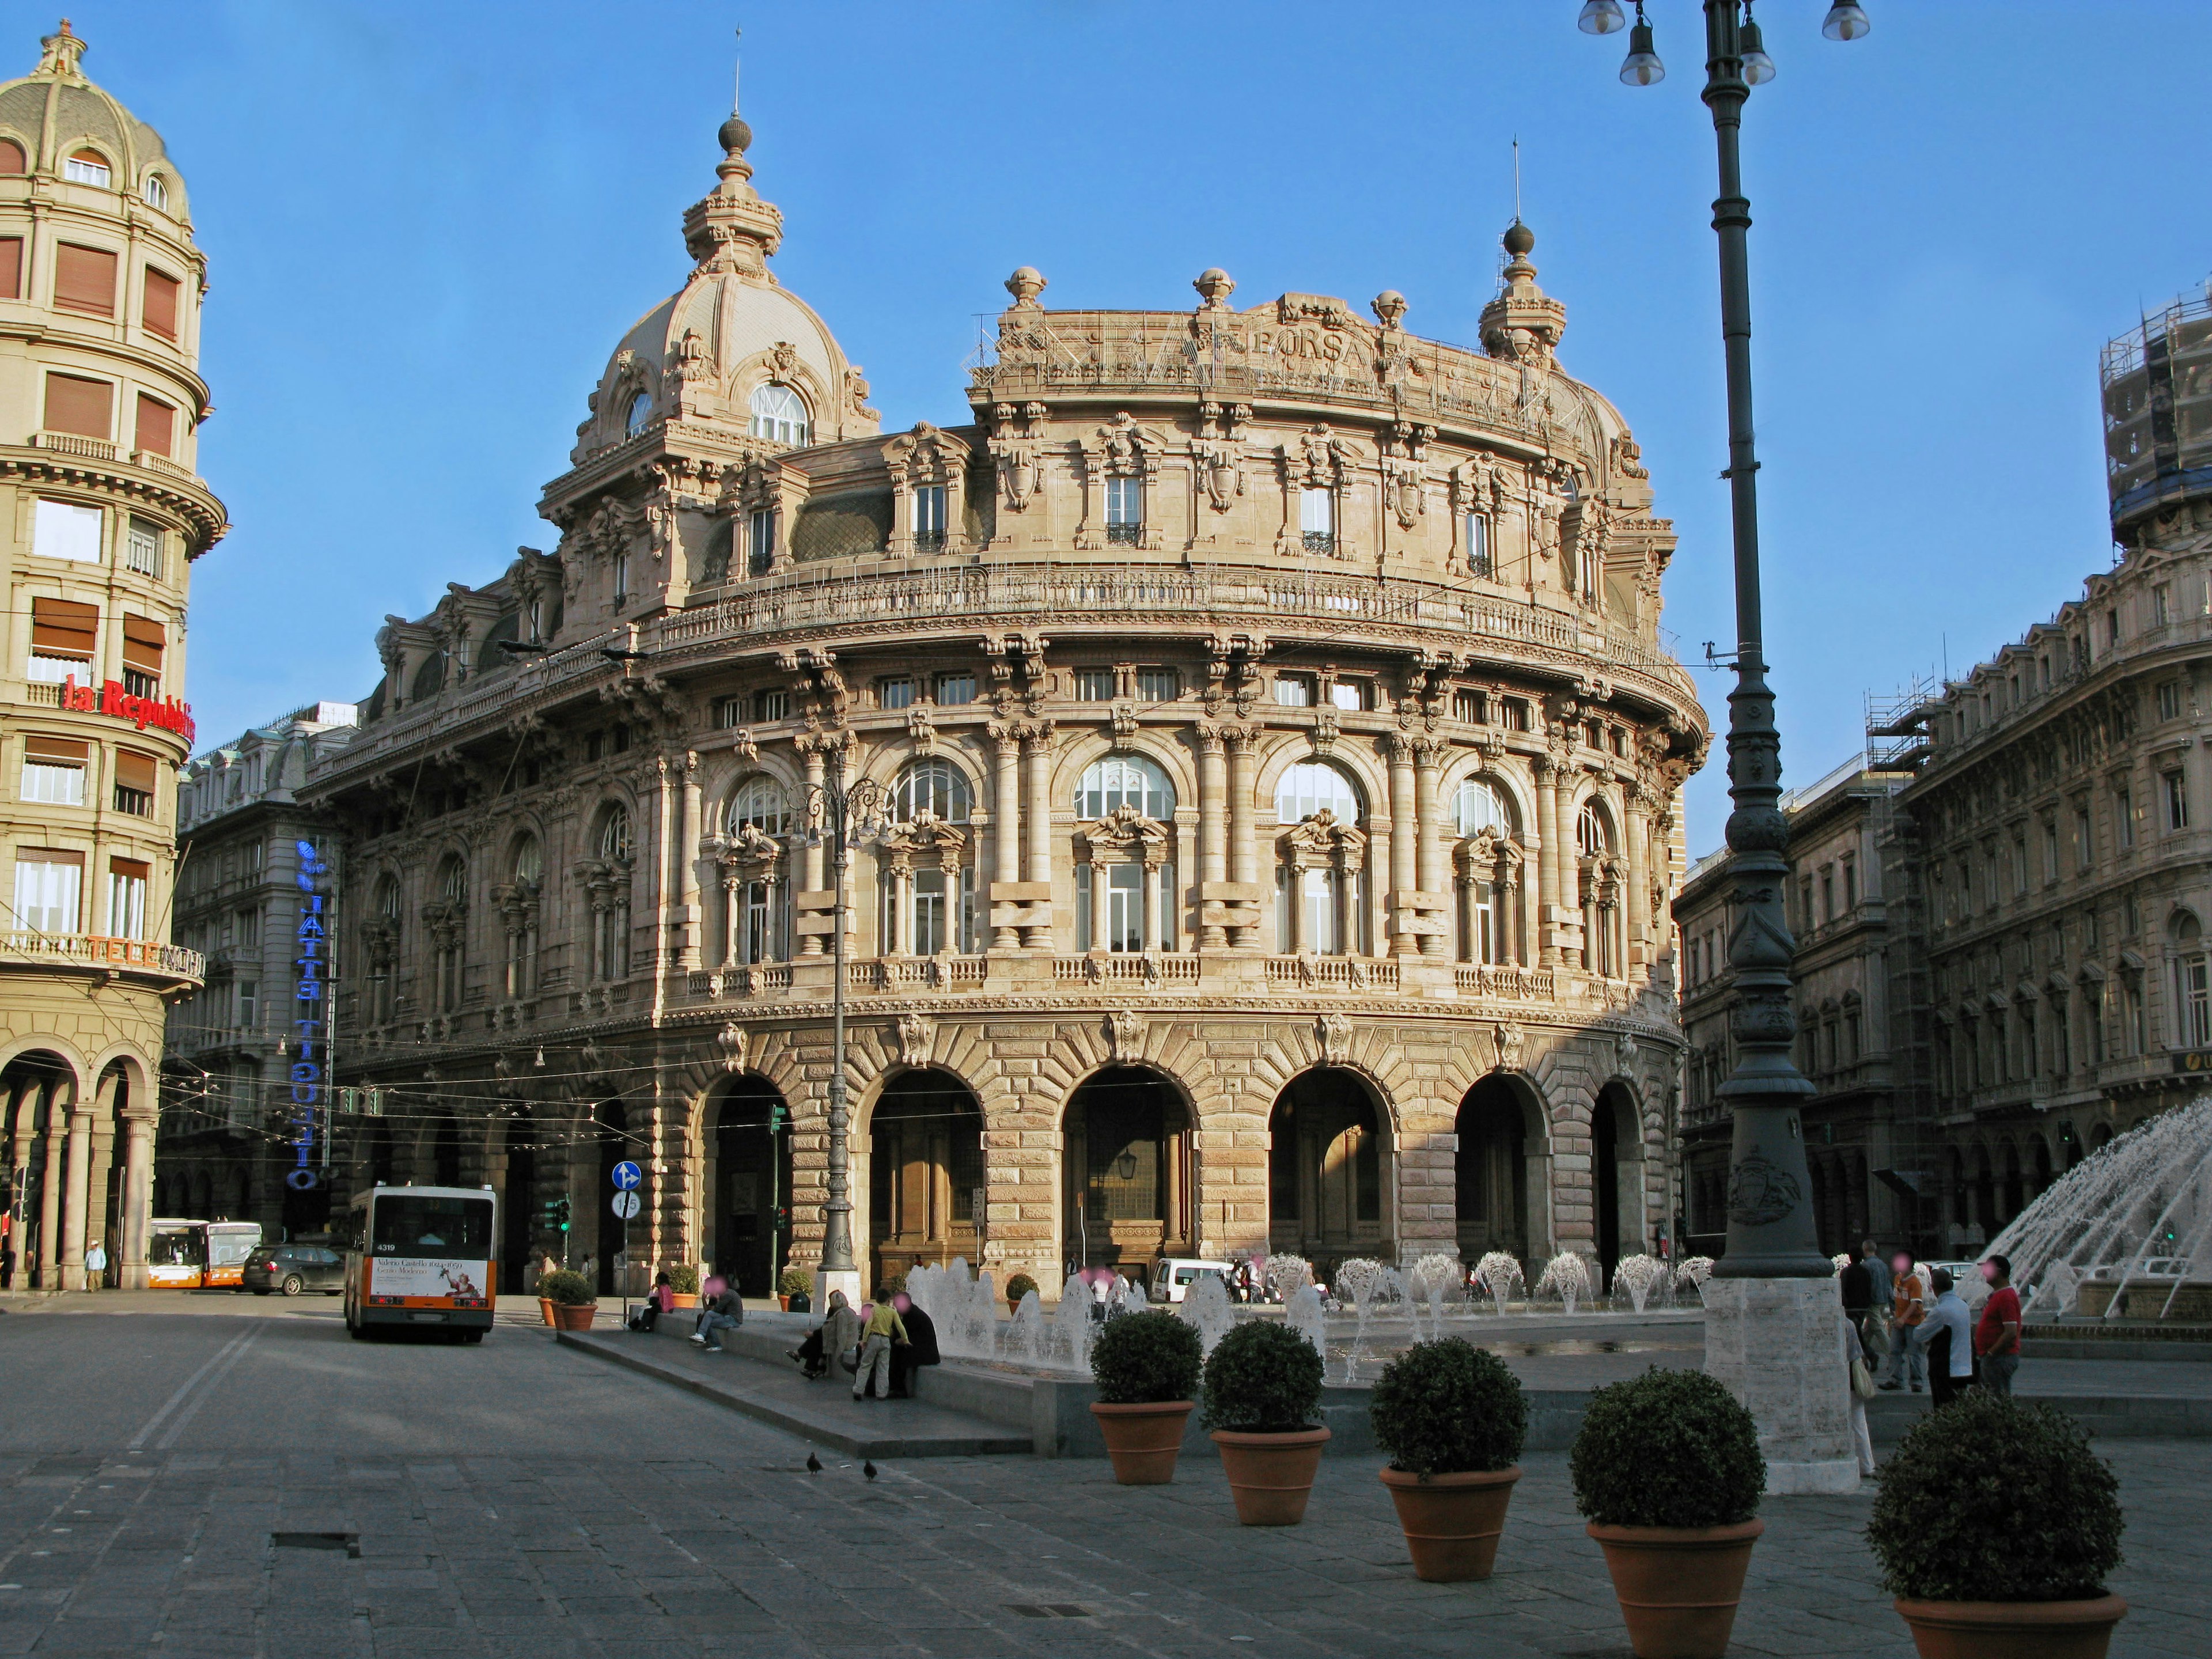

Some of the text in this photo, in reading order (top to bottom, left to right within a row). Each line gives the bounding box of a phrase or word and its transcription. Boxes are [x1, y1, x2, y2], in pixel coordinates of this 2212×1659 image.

[1253, 326, 1365, 369] BORSA
[62, 673, 95, 711] la
[618, 1199, 637, 1210] 15
[377, 1259, 400, 1267] Valerio
